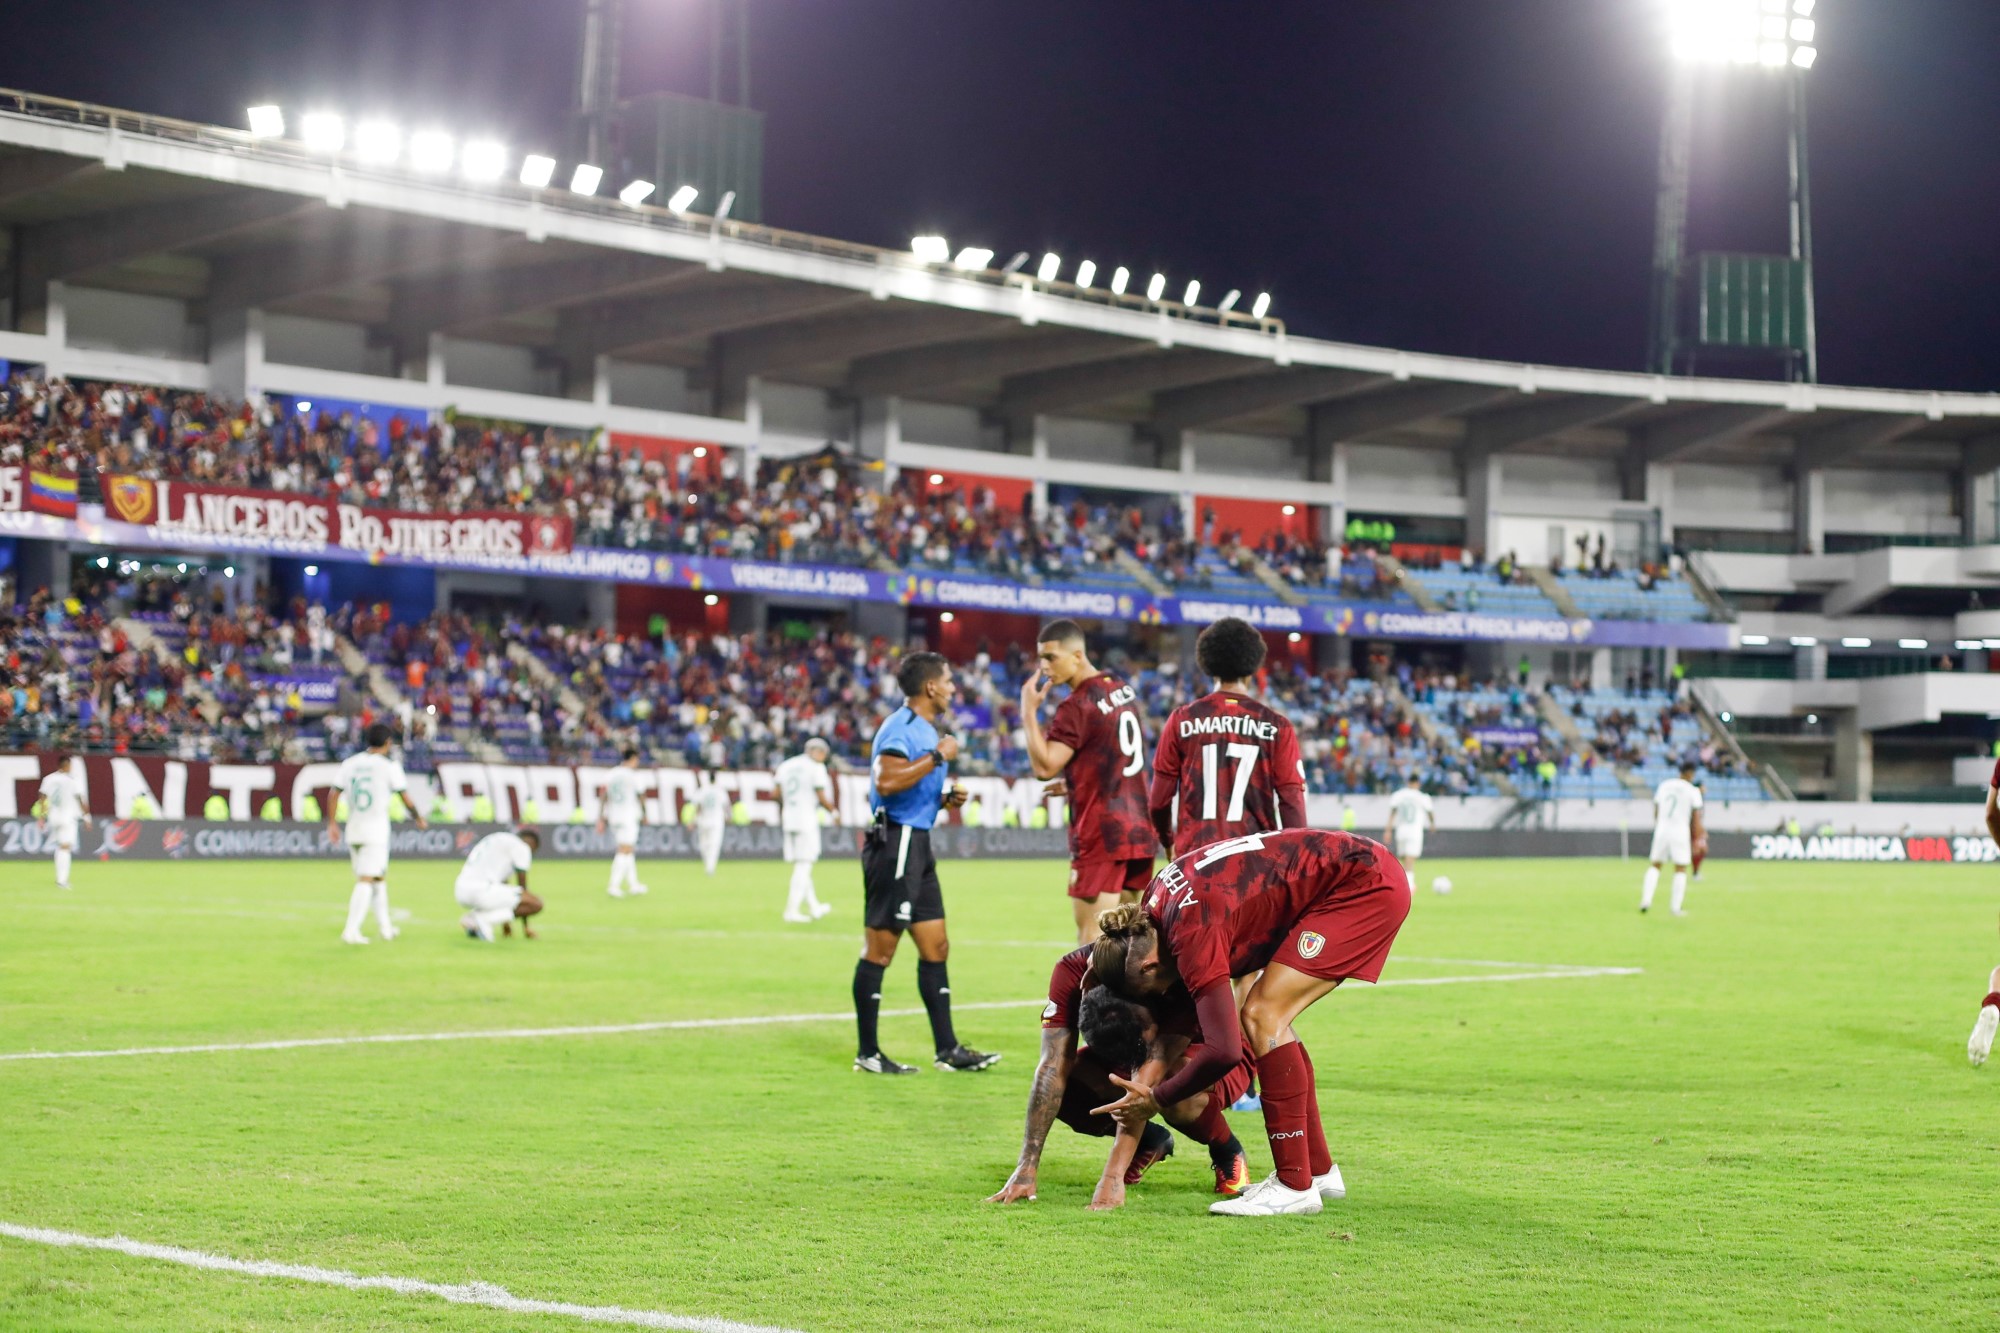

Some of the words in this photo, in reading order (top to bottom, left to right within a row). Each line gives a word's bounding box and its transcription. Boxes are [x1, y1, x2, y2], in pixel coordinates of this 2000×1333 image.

[155, 480, 329, 544] LANCEROS
[337, 504, 523, 556] ROJINEGROS
[731, 564, 826, 592] VENEZUELA
[827, 571, 869, 596] 2024
[937, 579, 1017, 608] CONMEBOL
[1180, 601, 1262, 624] VENEZUELA
[1381, 612, 1462, 636] CONMEBOL
[1119, 711, 1144, 777] 9
[1202, 743, 1260, 822] 17
[194, 829, 314, 854] CONMEBOL
[552, 824, 689, 852] CONBOL
[1806, 836, 1906, 860] AMERICA
[1906, 837, 1953, 862] USA
[1953, 837, 2000, 862] 202
